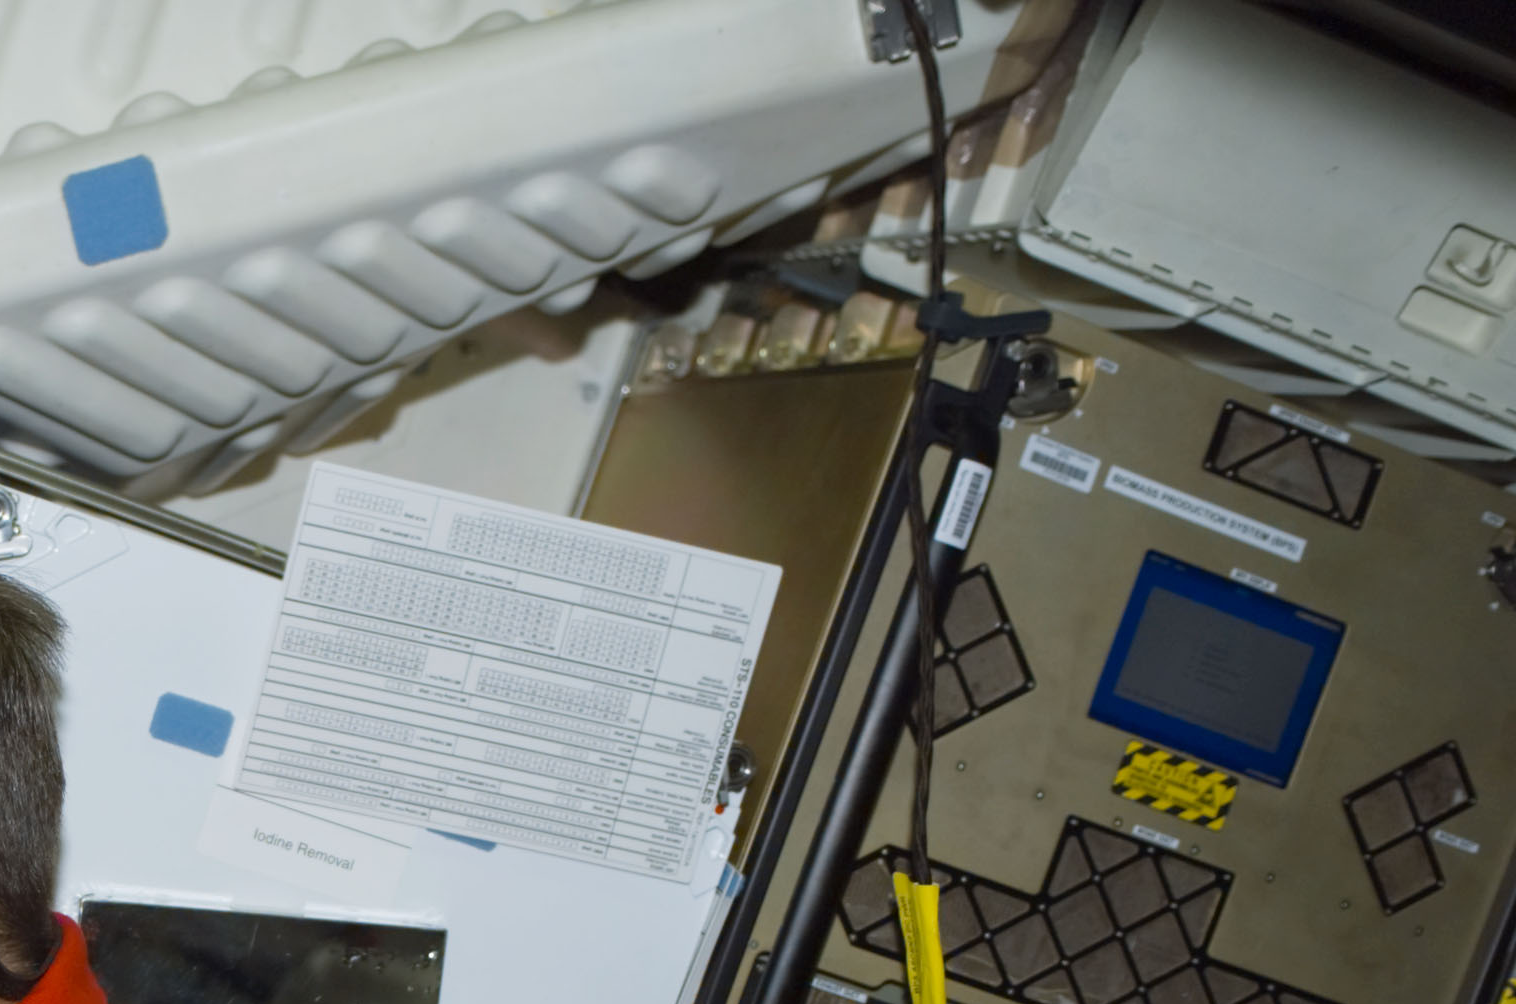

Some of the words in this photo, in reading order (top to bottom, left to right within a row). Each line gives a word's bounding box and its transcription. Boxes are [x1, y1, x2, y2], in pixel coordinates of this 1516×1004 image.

[1112, 474, 1159, 498] BIOMASS
[1161, 492, 1227, 524] PRODUCTION
[1229, 518, 1270, 541] SYSTEM
[729, 658, 752, 709] STS-110
[701, 711, 737, 805] CONSUMABLES
[253, 827, 293, 850] Iodine
[297, 842, 355, 871] Removal
